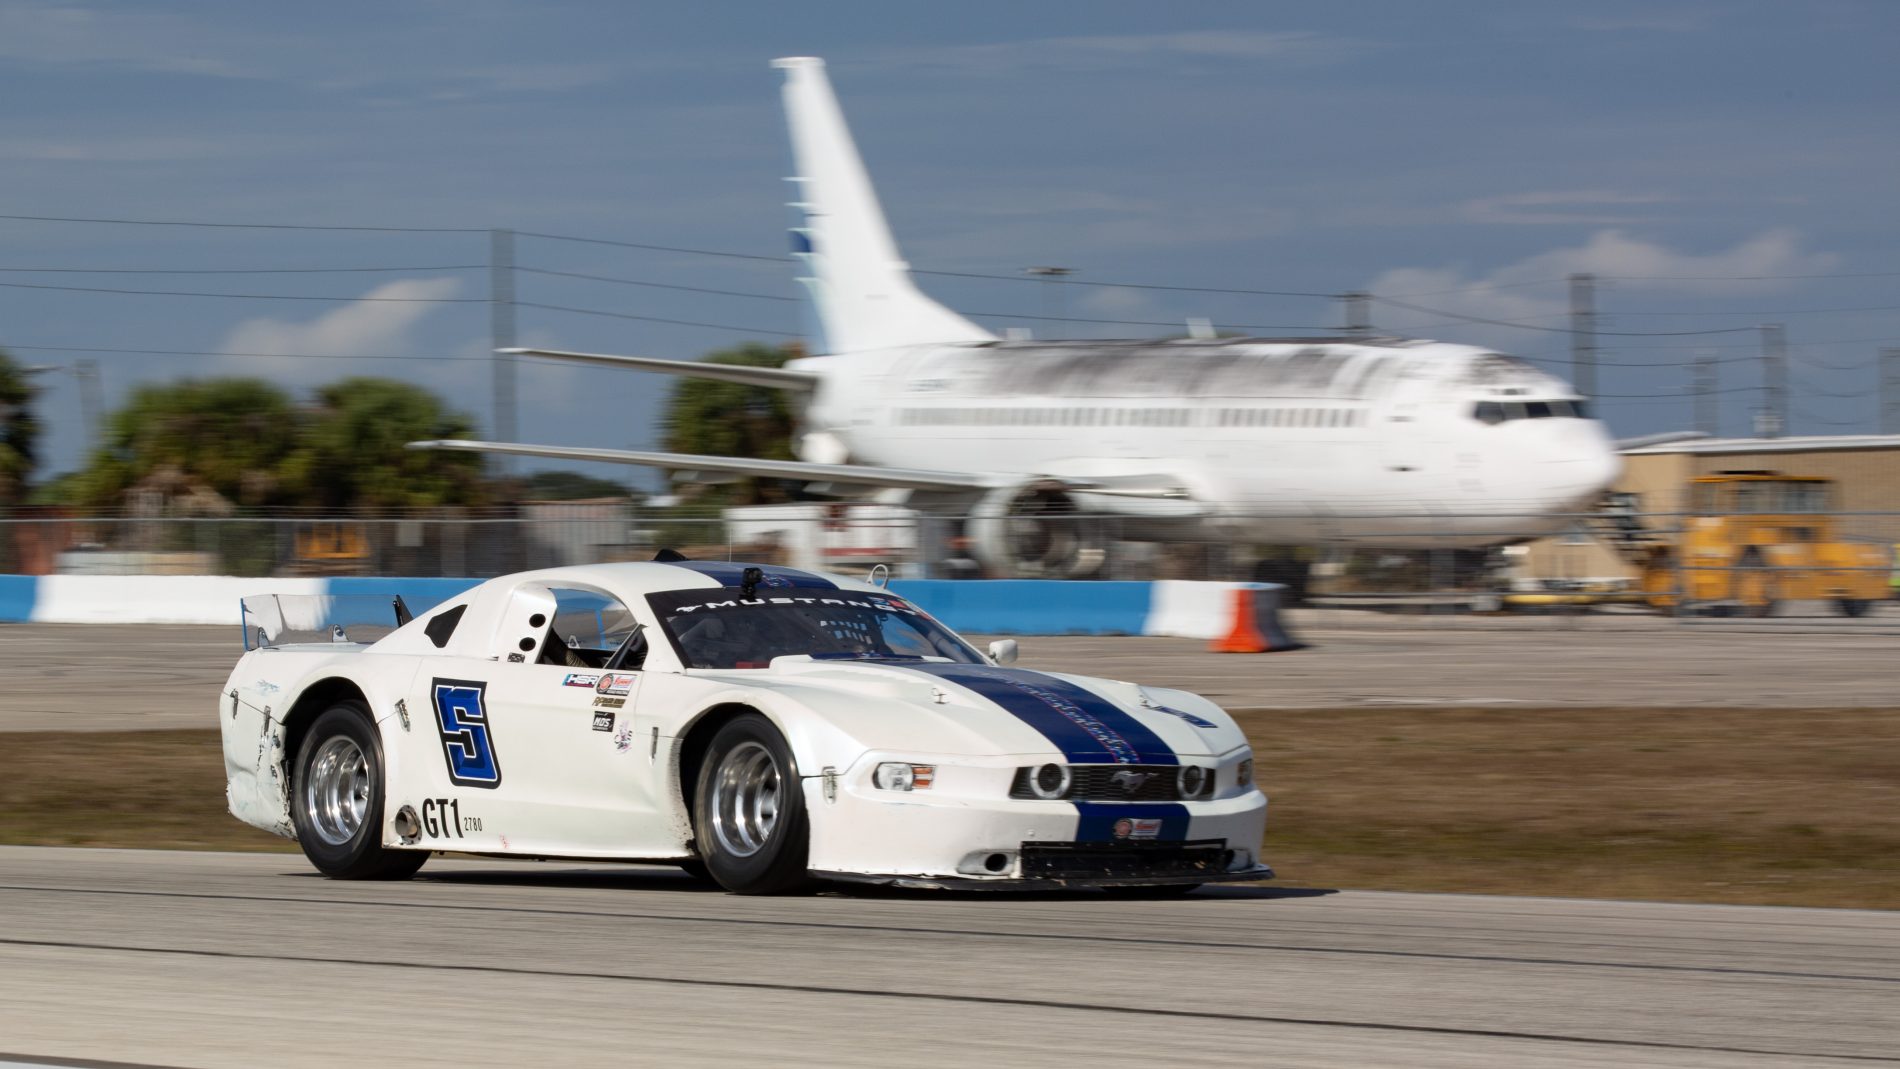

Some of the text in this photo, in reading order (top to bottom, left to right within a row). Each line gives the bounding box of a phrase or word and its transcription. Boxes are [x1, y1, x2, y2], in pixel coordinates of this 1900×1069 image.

[705, 597, 898, 612] MUSTANG
[567, 674, 599, 685] HSR
[433, 682, 500, 784] 5
[422, 798, 483, 839] GT1 2780
